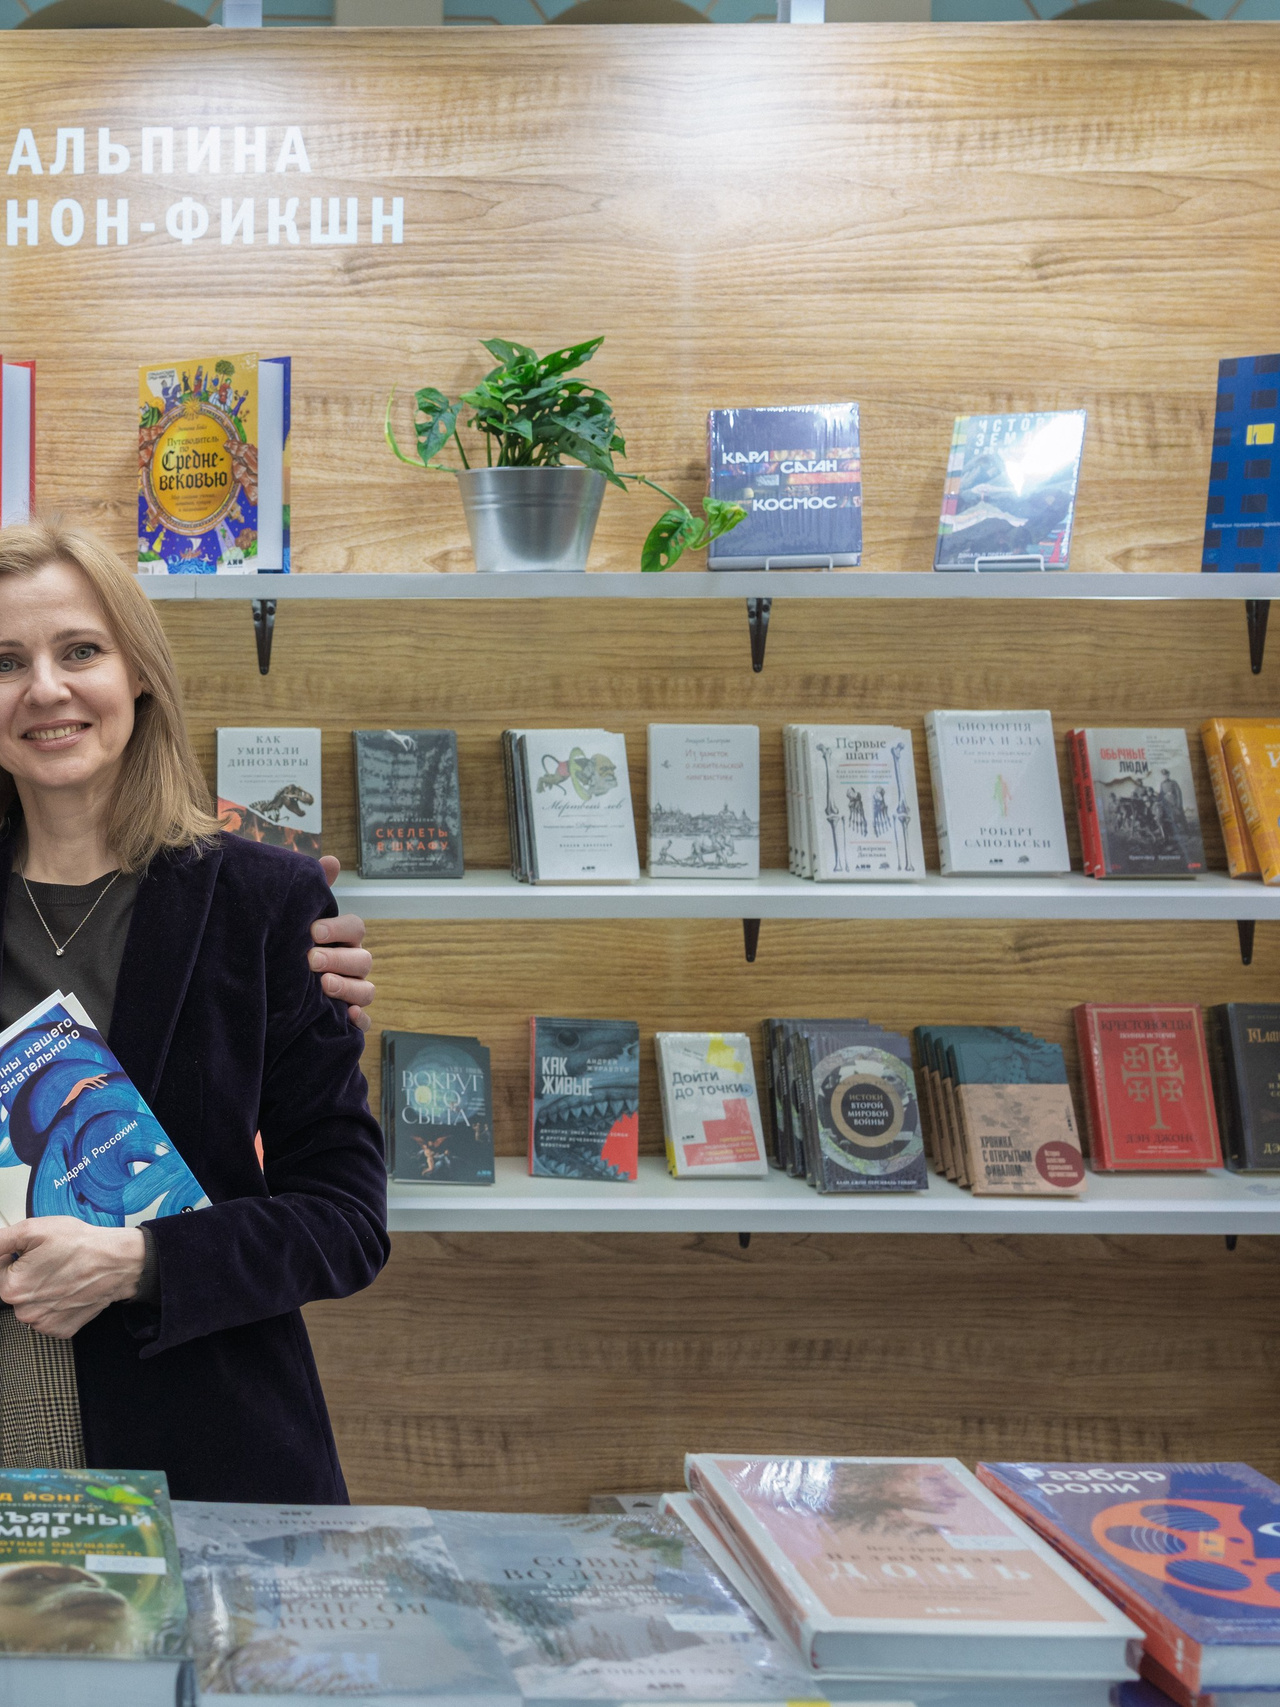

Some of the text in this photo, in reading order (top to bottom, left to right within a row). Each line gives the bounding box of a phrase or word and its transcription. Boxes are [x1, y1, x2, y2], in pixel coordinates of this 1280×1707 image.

[7, 126, 311, 176] АЛЬПИНА
[7, 195, 405, 249] НОН-ФИКШН
[167, 435, 219, 448] Путеводитель
[162, 448, 224, 474] Средне-
[722, 450, 769, 465] КАРЛ
[780, 459, 838, 474] САГАН
[159, 471, 228, 492] вековью
[752, 496, 838, 512] КОСМОС
[957, 722, 1032, 732] БИОЛОГИЯ
[256, 735, 281, 744] КАК
[835, 737, 887, 752] Первые
[951, 735, 995, 746] ДОБРА
[1016, 735, 1042, 746] ЗЛА
[237, 746, 300, 755] УМИРАЛИ
[845, 750, 879, 761] шаги
[1100, 748, 1146, 760] ОБЫЧНЫЕ
[227, 758, 309, 768] ДИНОЗАВРЫ
[1119, 760, 1149, 774] ЛЮДИ
[375, 828, 448, 839] СКЕЛЕТЫ
[980, 827, 1033, 837] РОБЕРТ
[376, 841, 448, 852] В ШКАФУ
[964, 839, 1052, 849] САПОЛЬСКИ
[1100, 1020, 1193, 1031] КРЕСТОНОСЦЫ
[24, 1017, 73, 1058] нашего
[541, 1056, 568, 1076] КАК
[586, 1058, 618, 1066] АНДРЕЙ
[402, 1070, 484, 1095] ВОКРУГ
[672, 1069, 719, 1087] Дойти
[541, 1076, 593, 1097] ЖИВЫЕ
[675, 1083, 748, 1100] до точки.
[401, 1086, 461, 1107] ТОГО
[849, 1093, 883, 1101] ИСТОКИ
[851, 1100, 884, 1110] ВТОРОЙ
[401, 1105, 471, 1127] СВЕТА
[847, 1108, 889, 1118] МИРОВОЙ
[853, 1117, 885, 1126] ВОЙНЫ
[980, 1135, 1013, 1148] ХРОНИКА
[53, 1119, 139, 1190] Андрей Россохин
[989, 1149, 1033, 1163] ОТКРЫТЫМ
[985, 1164, 1023, 1177] ФИНАЛОМ
[1019, 1466, 1167, 1483] Разбор
[1036, 1481, 1141, 1496] роли
[22, 1491, 84, 1502] ЙОНГ
[17, 1547, 46, 1555] НАС
[51, 1548, 143, 1557] РЕАЛЬНОСТЬ
[51, 1541, 126, 1550] ОЩУЩАЮТ
[532, 1556, 640, 1569] СОВЫ
[503, 1568, 552, 1581] ВО
